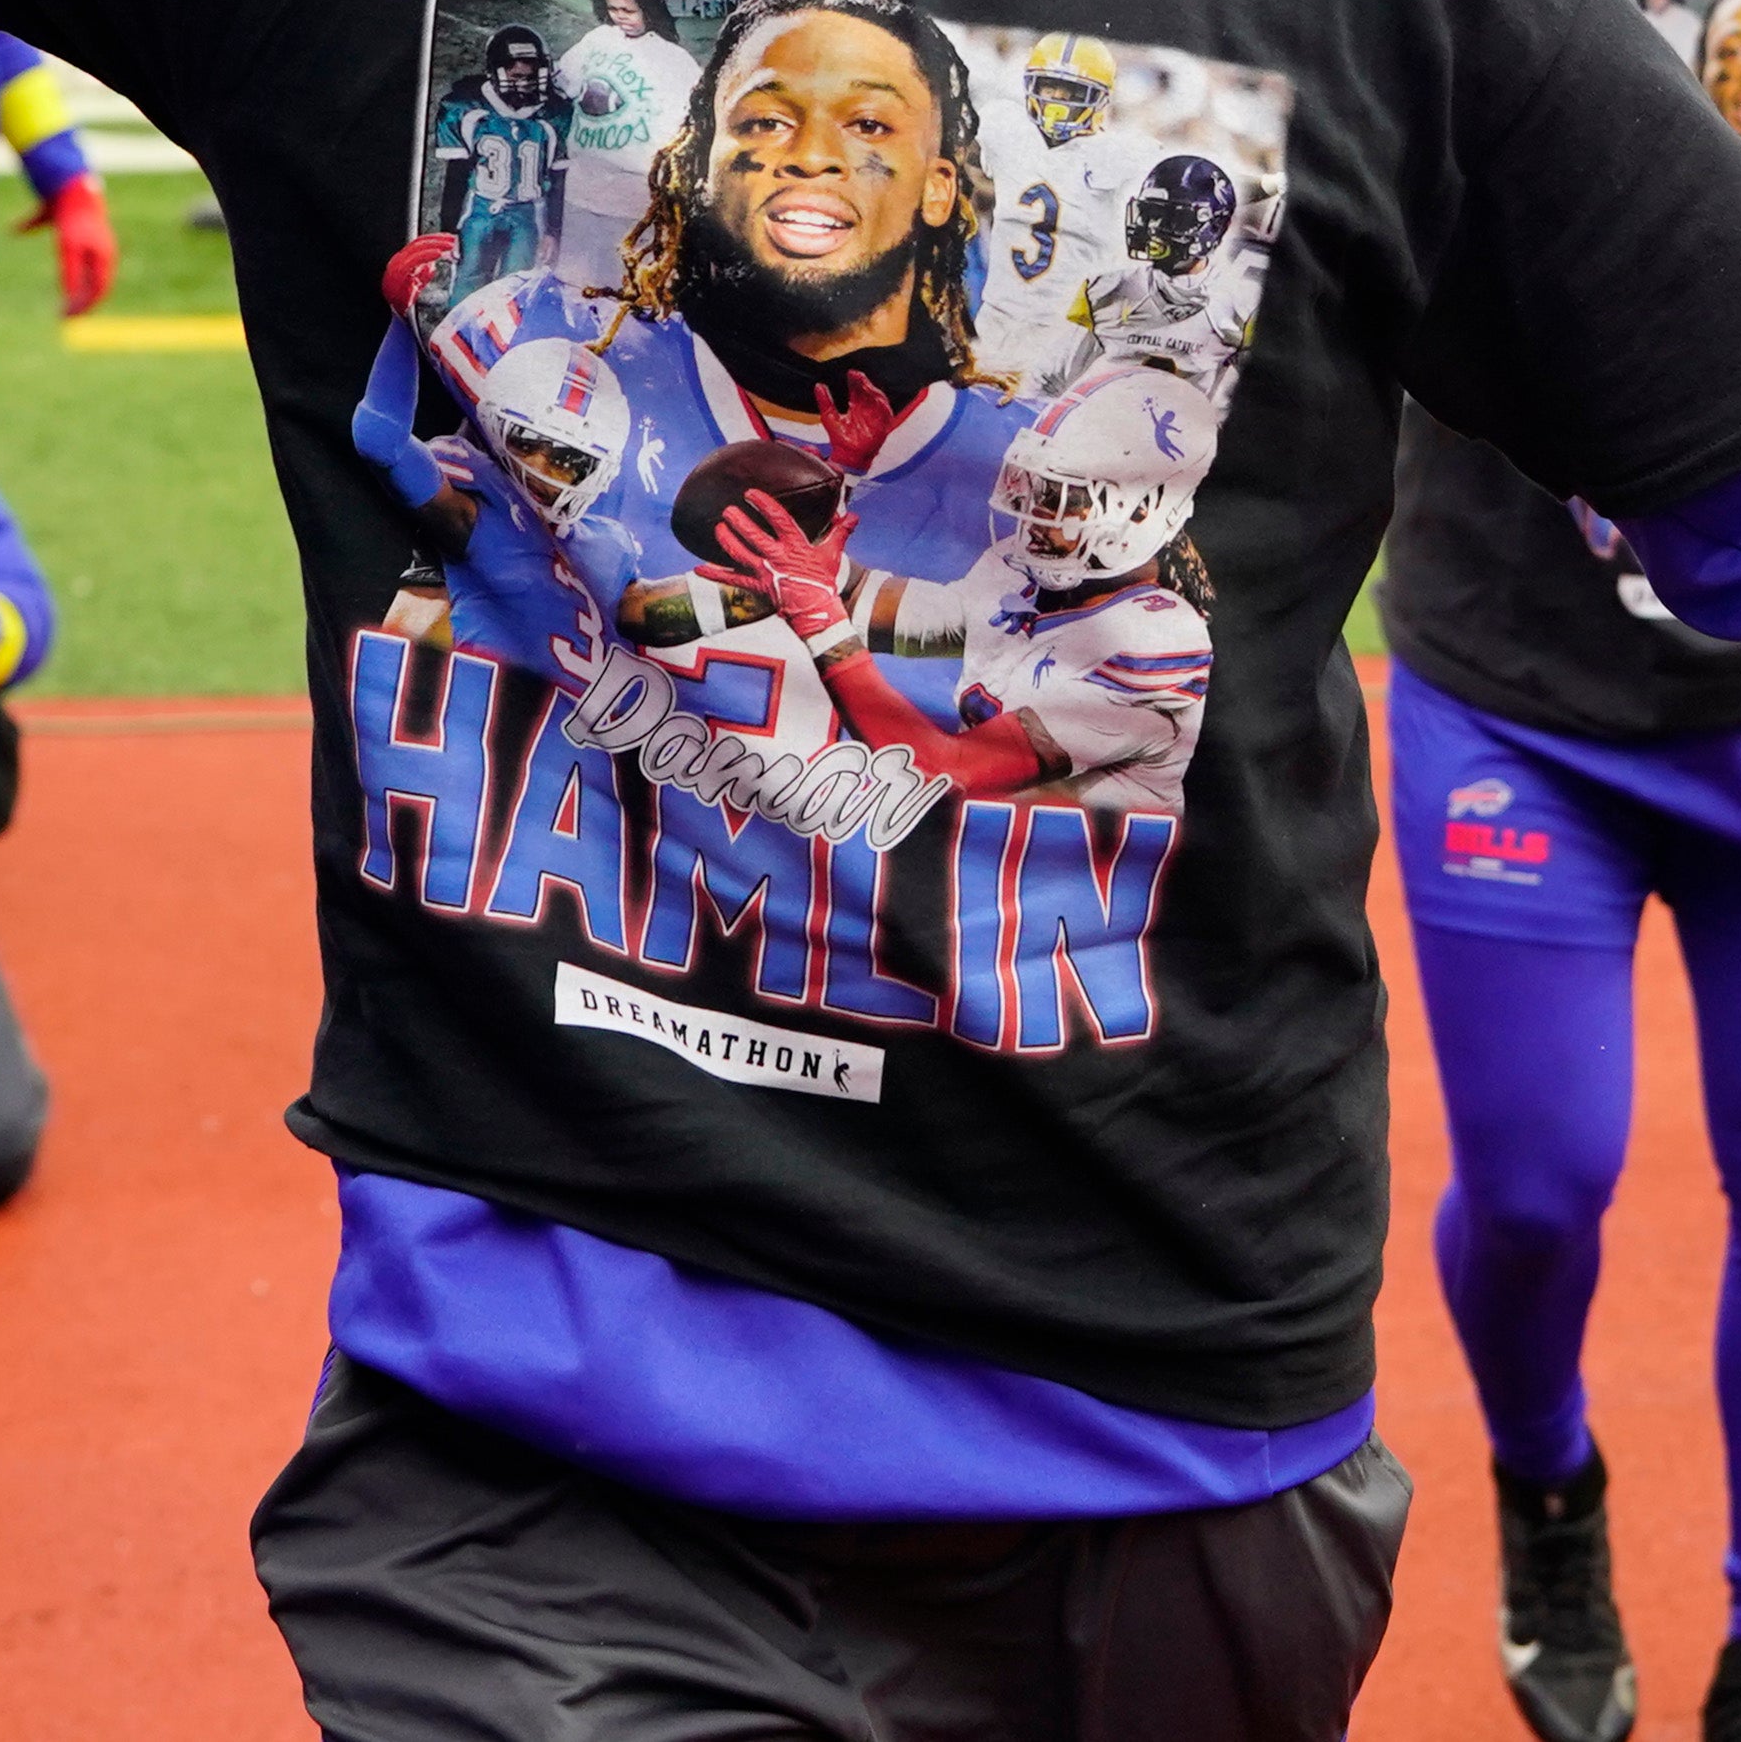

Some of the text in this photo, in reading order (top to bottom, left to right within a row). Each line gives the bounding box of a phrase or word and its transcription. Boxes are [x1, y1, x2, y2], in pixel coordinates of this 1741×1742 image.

[476, 135, 542, 201] 31
[1012, 182, 1060, 282] 3
[561, 642, 952, 852] Damar
[350, 628, 1176, 1052] HAMLIN
[580, 988, 821, 1079] DREAMATHON
